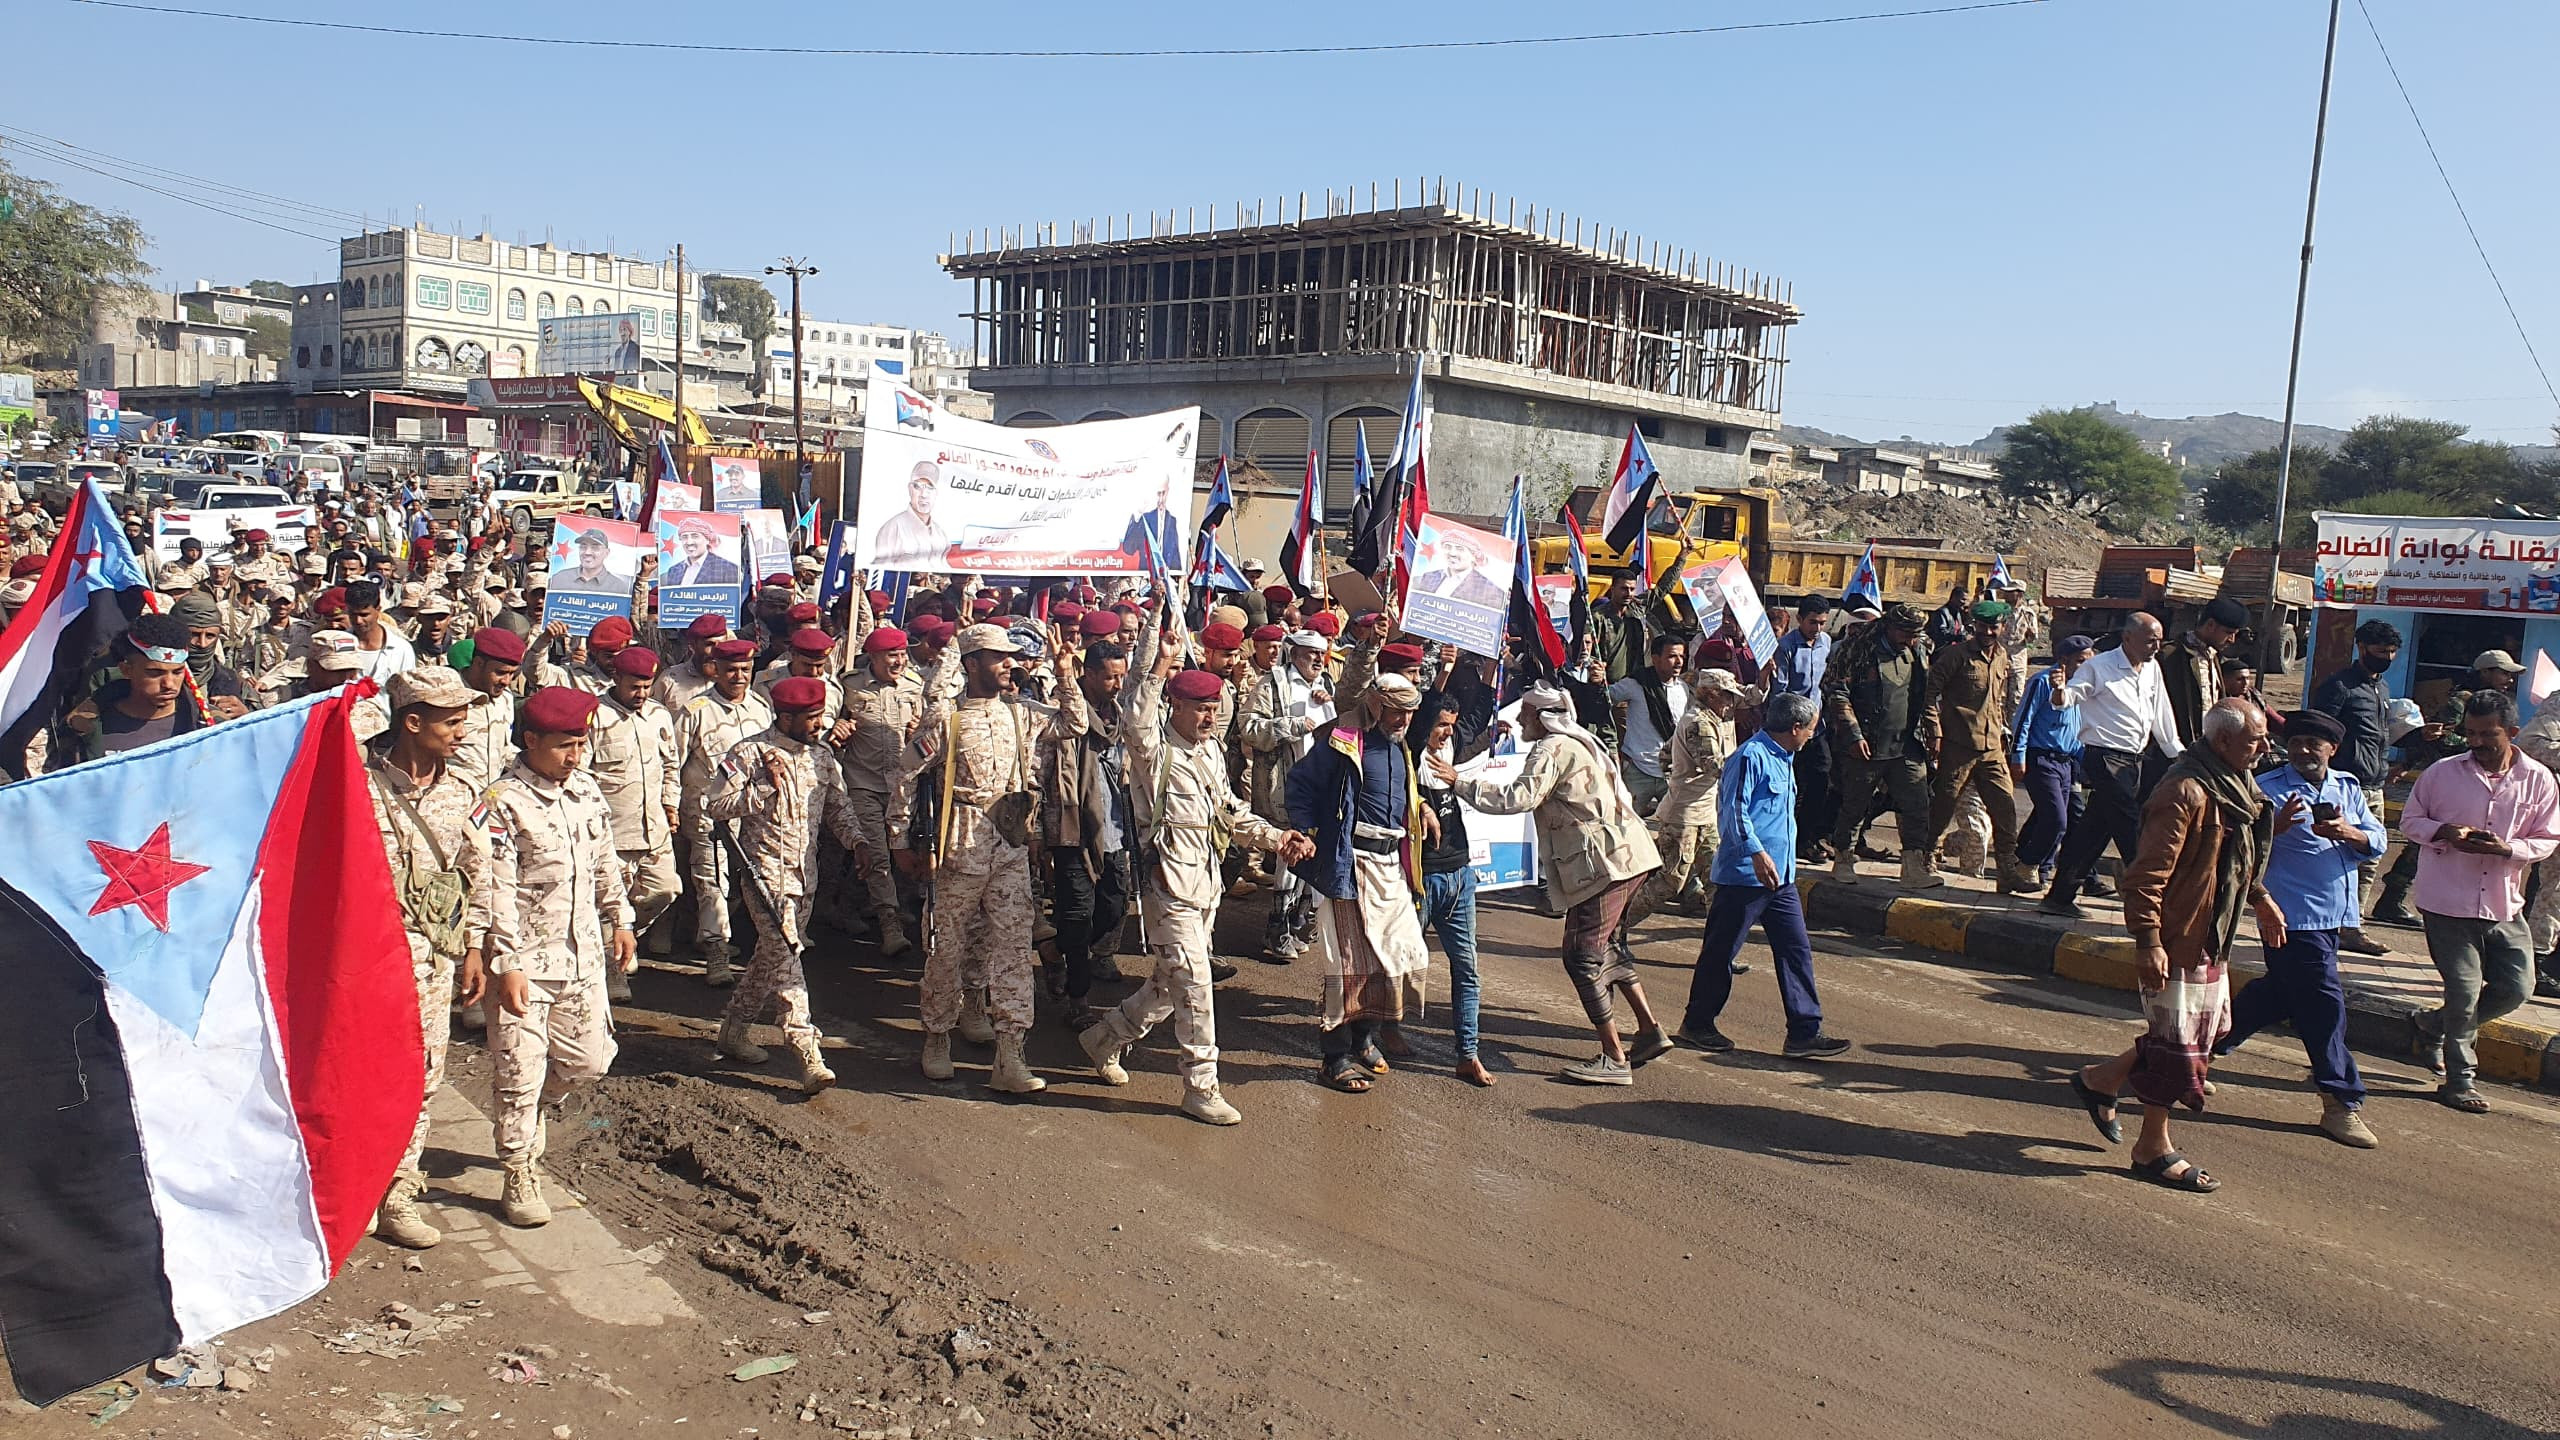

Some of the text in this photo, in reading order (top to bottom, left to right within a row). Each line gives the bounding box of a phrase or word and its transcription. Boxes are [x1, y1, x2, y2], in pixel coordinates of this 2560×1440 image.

[522, 382, 544, 395] للخدمات
[936, 449, 972, 464] الضالع
[950, 475, 984, 494] عليها
[986, 482, 1017, 497] أقدم
[1018, 486, 1046, 502] التي
[2316, 536, 2559, 569] بقالة بوابة الضالع
[2347, 568, 2364, 579] فوري
[2364, 568, 2379, 578] شحن
[2490, 574, 2506, 583] مواد
[557, 595, 618, 612] الرئيس القائد/
[669, 591, 728, 601] الرئيس القائد/
[1420, 596, 1489, 625] الرئيس القائد/
[1482, 759, 1508, 772] مجلس
